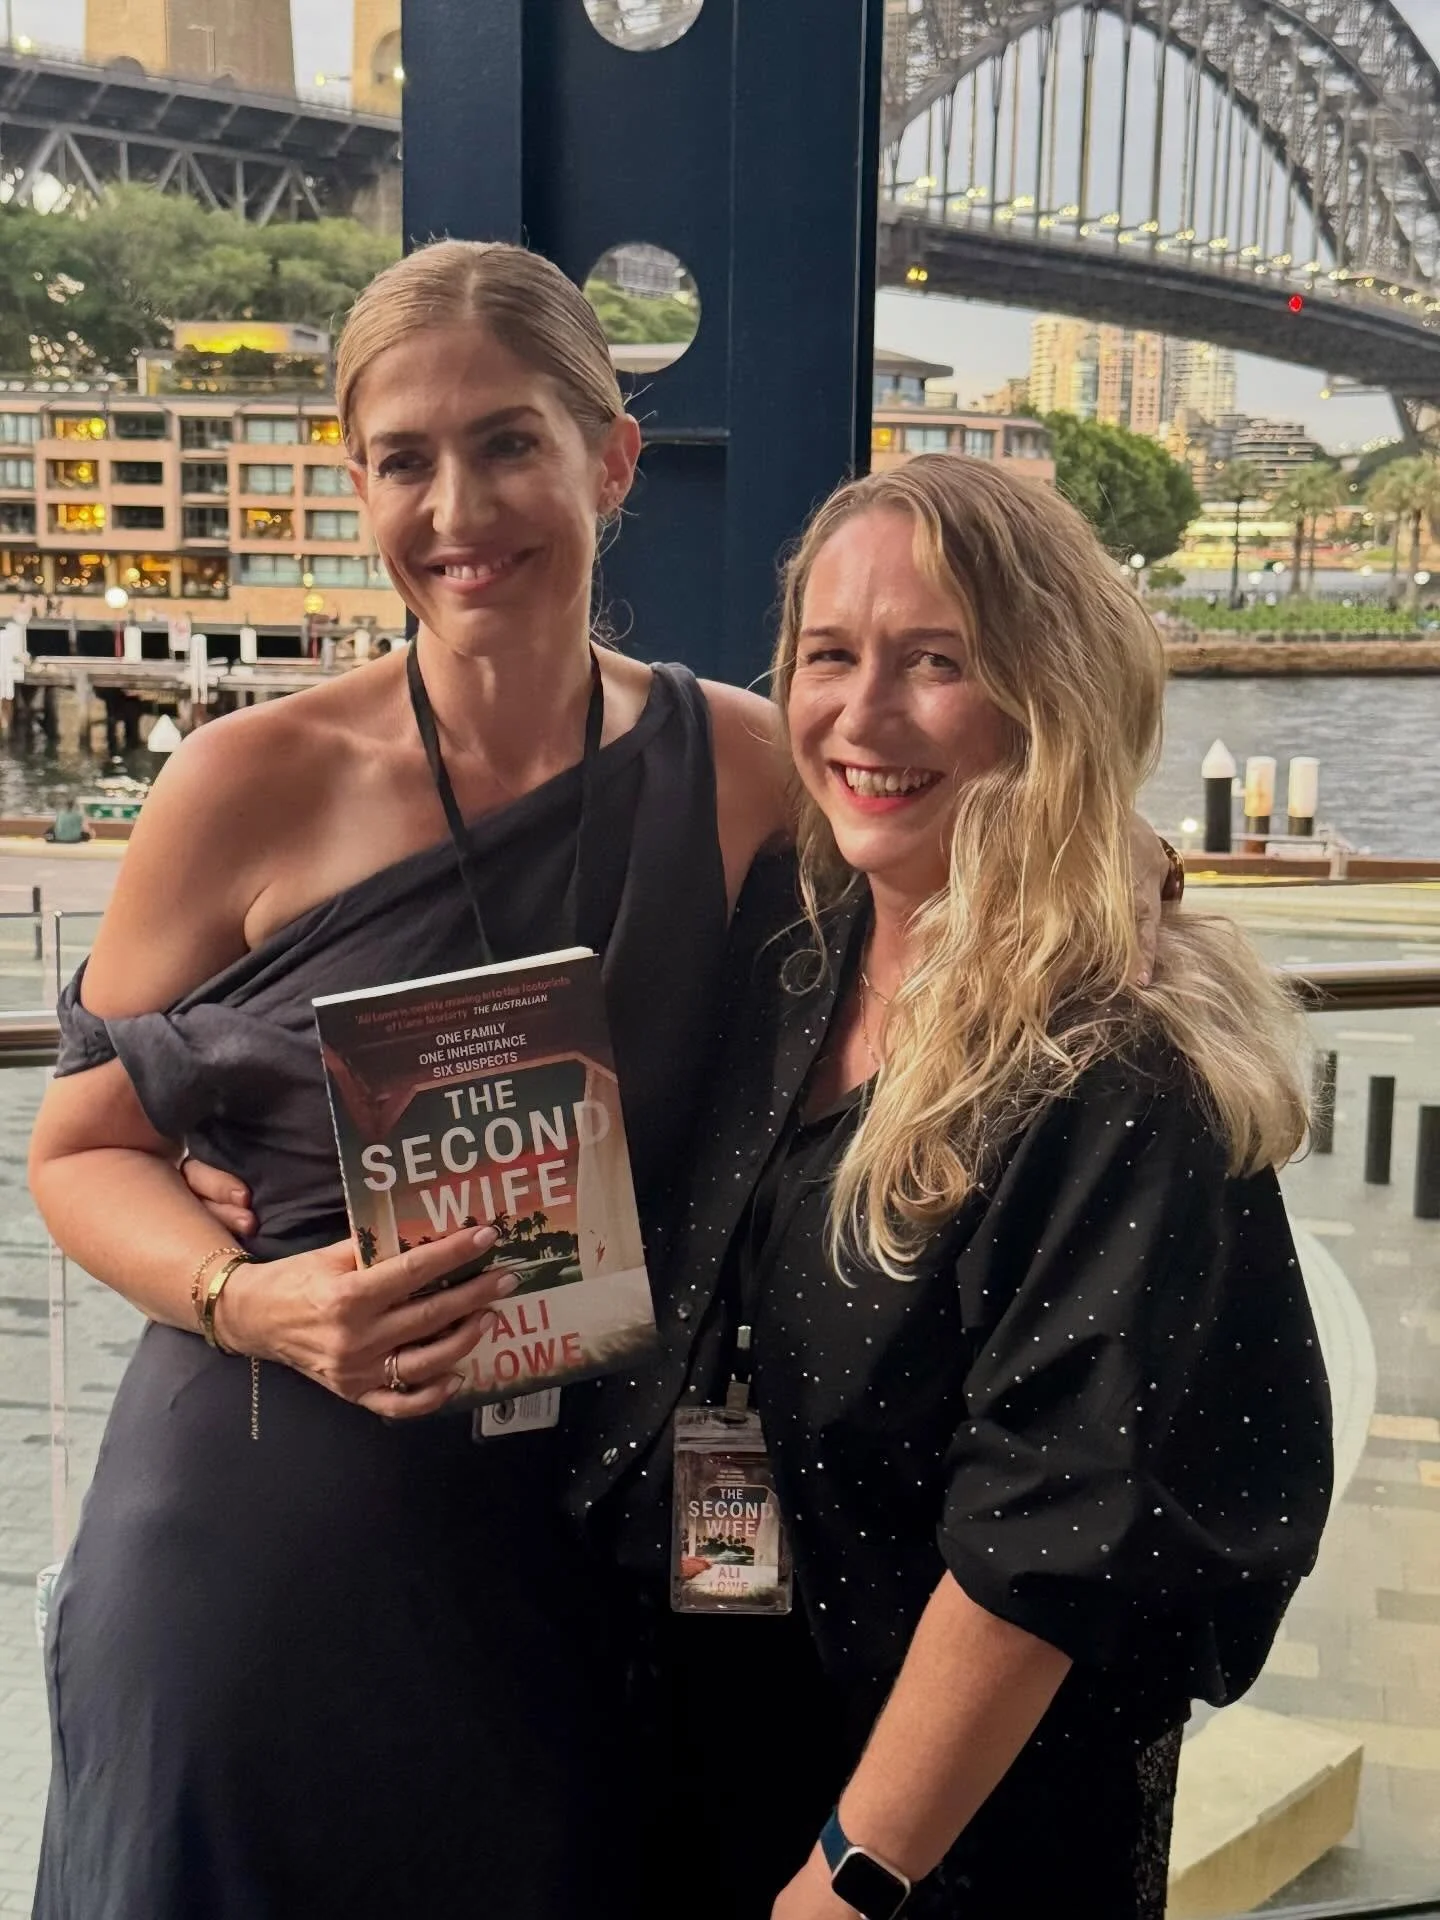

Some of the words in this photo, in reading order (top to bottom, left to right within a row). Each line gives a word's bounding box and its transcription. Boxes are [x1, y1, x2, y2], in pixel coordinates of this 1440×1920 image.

[473, 1005, 490, 1015] THE
[491, 994, 548, 1012] AUSTRALIAN
[436, 1031, 463, 1046] ONE
[463, 1023, 506, 1040] FAMILY
[419, 1050, 446, 1065] ONE
[447, 1034, 527, 1059] INHERITANCE
[433, 1064, 453, 1078] SIX
[455, 1052, 518, 1073] SUSPECTS
[444, 1079, 517, 1120] THE
[361, 1100, 611, 1192] SECOND
[419, 1159, 571, 1233] WIFE
[491, 1299, 550, 1343] ALI
[471, 1331, 587, 1390] LOWE
[719, 1488, 744, 1500] THE
[688, 1500, 774, 1520] SECOND
[705, 1519, 757, 1538] WIFE
[718, 1566, 741, 1579] ALI
